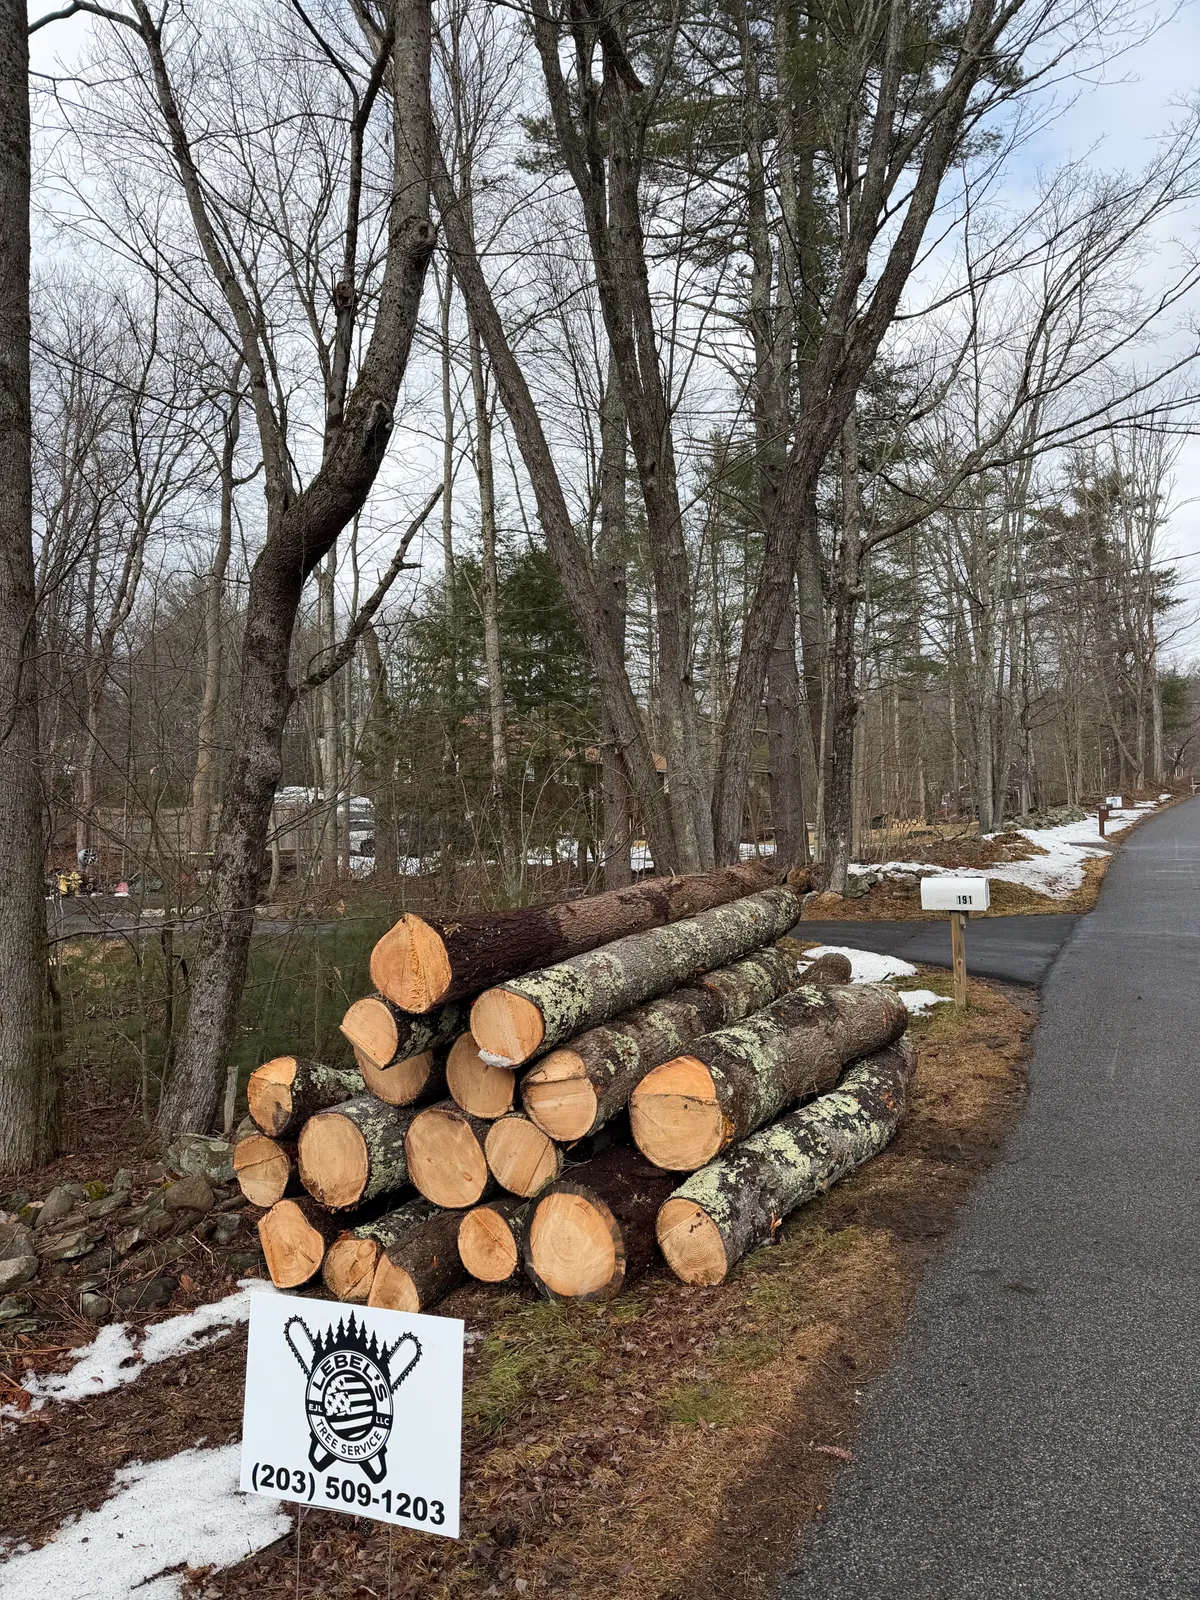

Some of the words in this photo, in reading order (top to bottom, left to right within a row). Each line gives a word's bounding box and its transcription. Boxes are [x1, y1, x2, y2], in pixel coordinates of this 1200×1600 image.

[957, 895, 972, 905] 191
[312, 1354, 388, 1402] LEBEL'S
[308, 1403, 323, 1413] EJL
[375, 1417, 390, 1426] LLC
[316, 1418, 338, 1450] TREE
[341, 1430, 383, 1456] SERVICE
[252, 1462, 316, 1501] (203)
[325, 1476, 445, 1525] 509-1203
